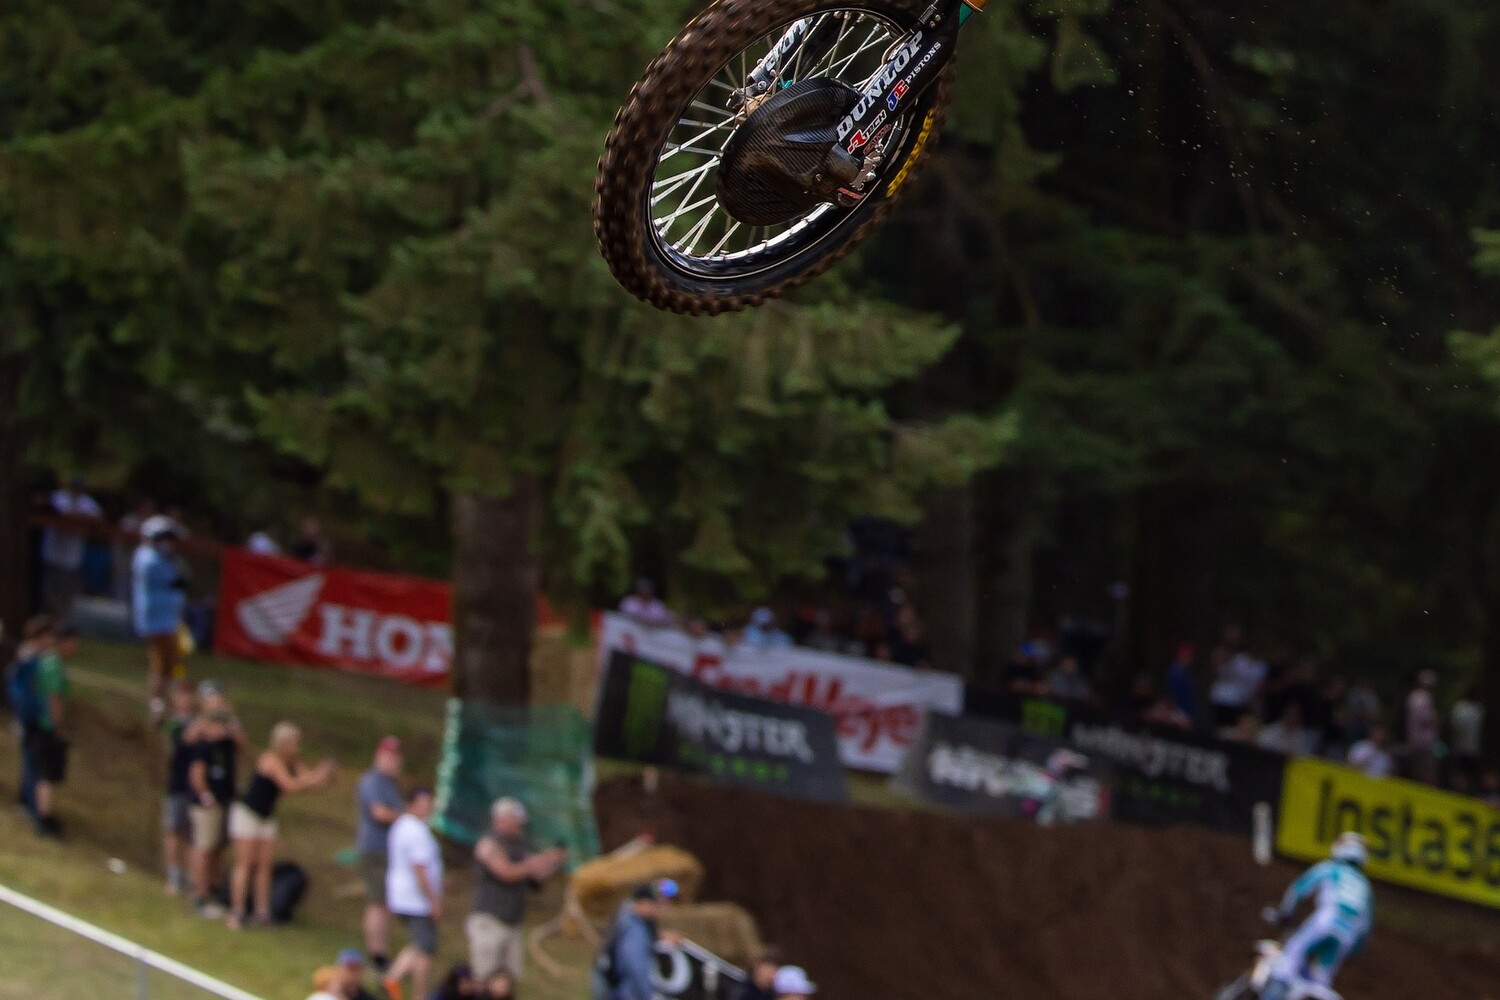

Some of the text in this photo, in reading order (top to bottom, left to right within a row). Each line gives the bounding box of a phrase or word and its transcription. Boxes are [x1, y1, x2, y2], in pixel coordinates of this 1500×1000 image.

[836, 30, 923, 142] DUNLOP
[886, 41, 942, 112] JE PISTONS
